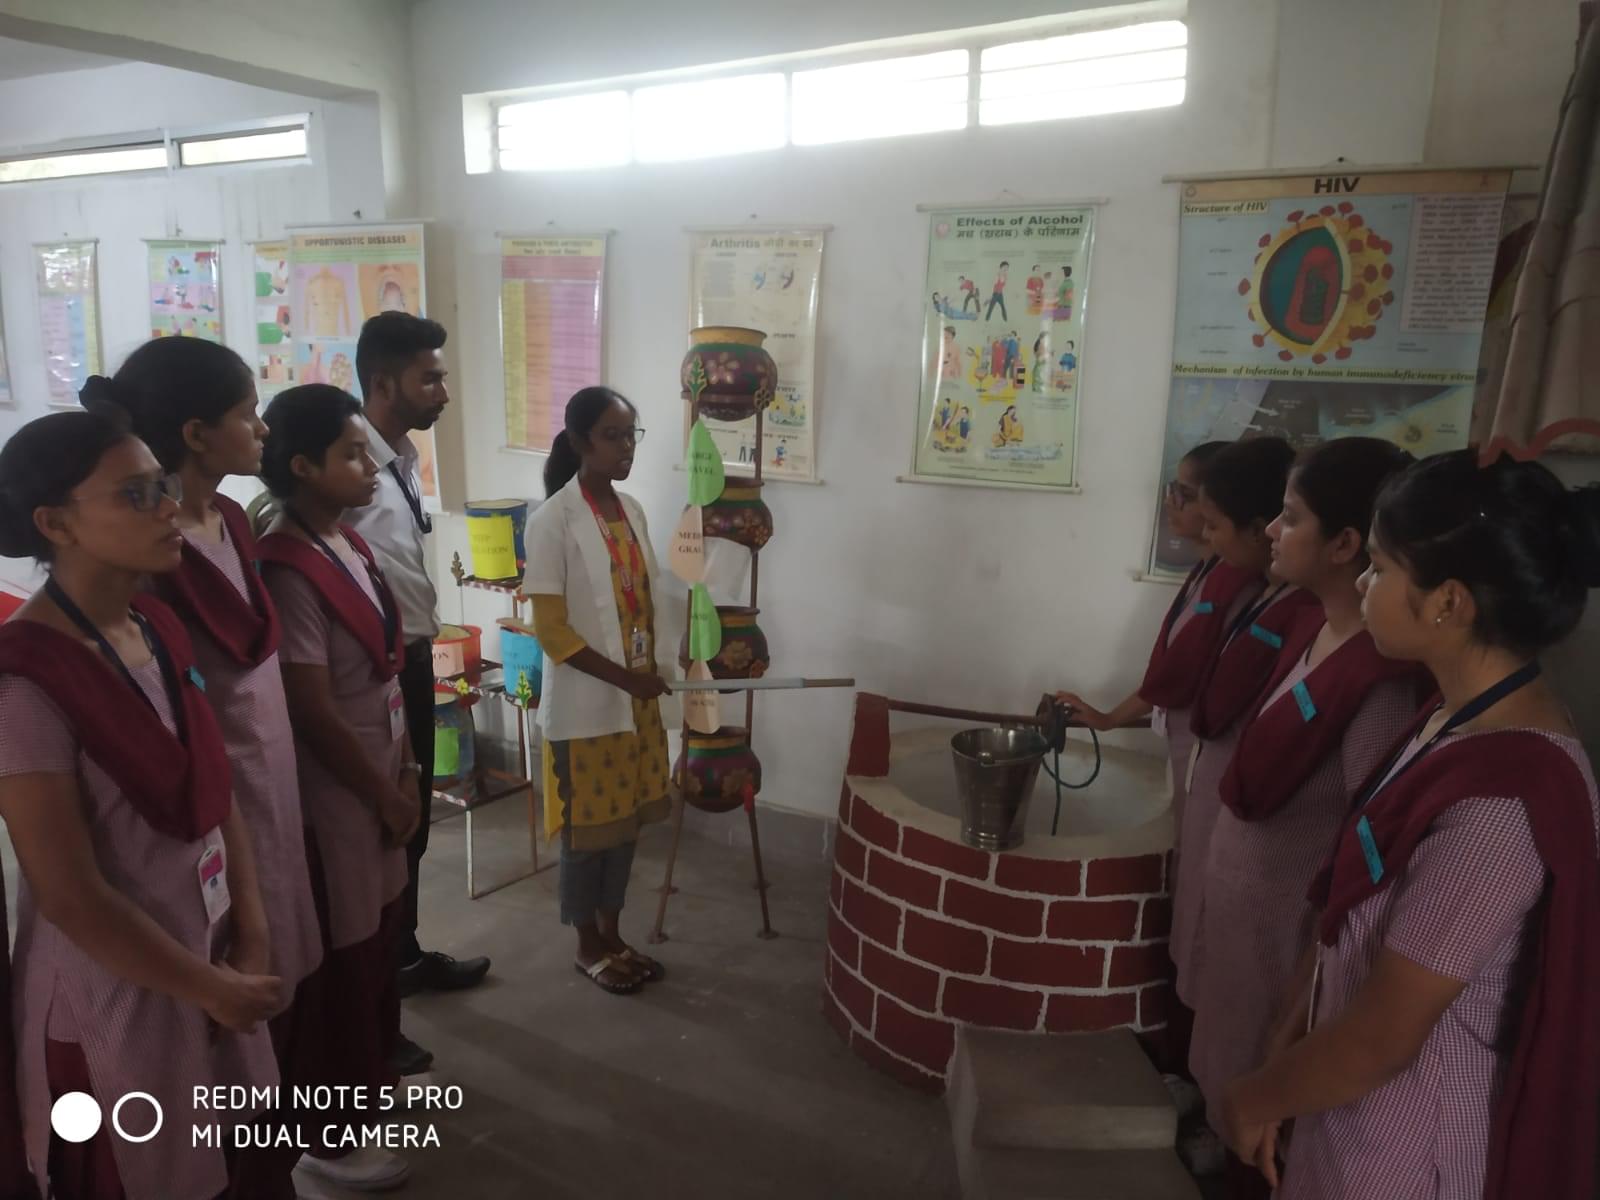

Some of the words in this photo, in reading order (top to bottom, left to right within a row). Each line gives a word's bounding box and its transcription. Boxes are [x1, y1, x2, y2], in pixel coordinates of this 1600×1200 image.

[1314, 177, 1361, 194] HIV
[1184, 203, 1230, 214] Structure
[1233, 202, 1244, 213] of
[1246, 201, 1268, 211] HIV
[956, 217, 1005, 227] Effects
[1010, 216, 1024, 225] of
[1028, 214, 1083, 225] Alcohol
[304, 236, 365, 247] OPPORTUNISTIC
[367, 235, 407, 245] DISEASES
[710, 237, 760, 248] Arthritis
[1174, 364, 1228, 374] Mechanism
[1233, 365, 1243, 376] of
[1245, 366, 1290, 376] infection
[1292, 367, 1305, 377] by
[1307, 368, 1344, 377] human
[1346, 369, 1447, 382] immunodeficiency
